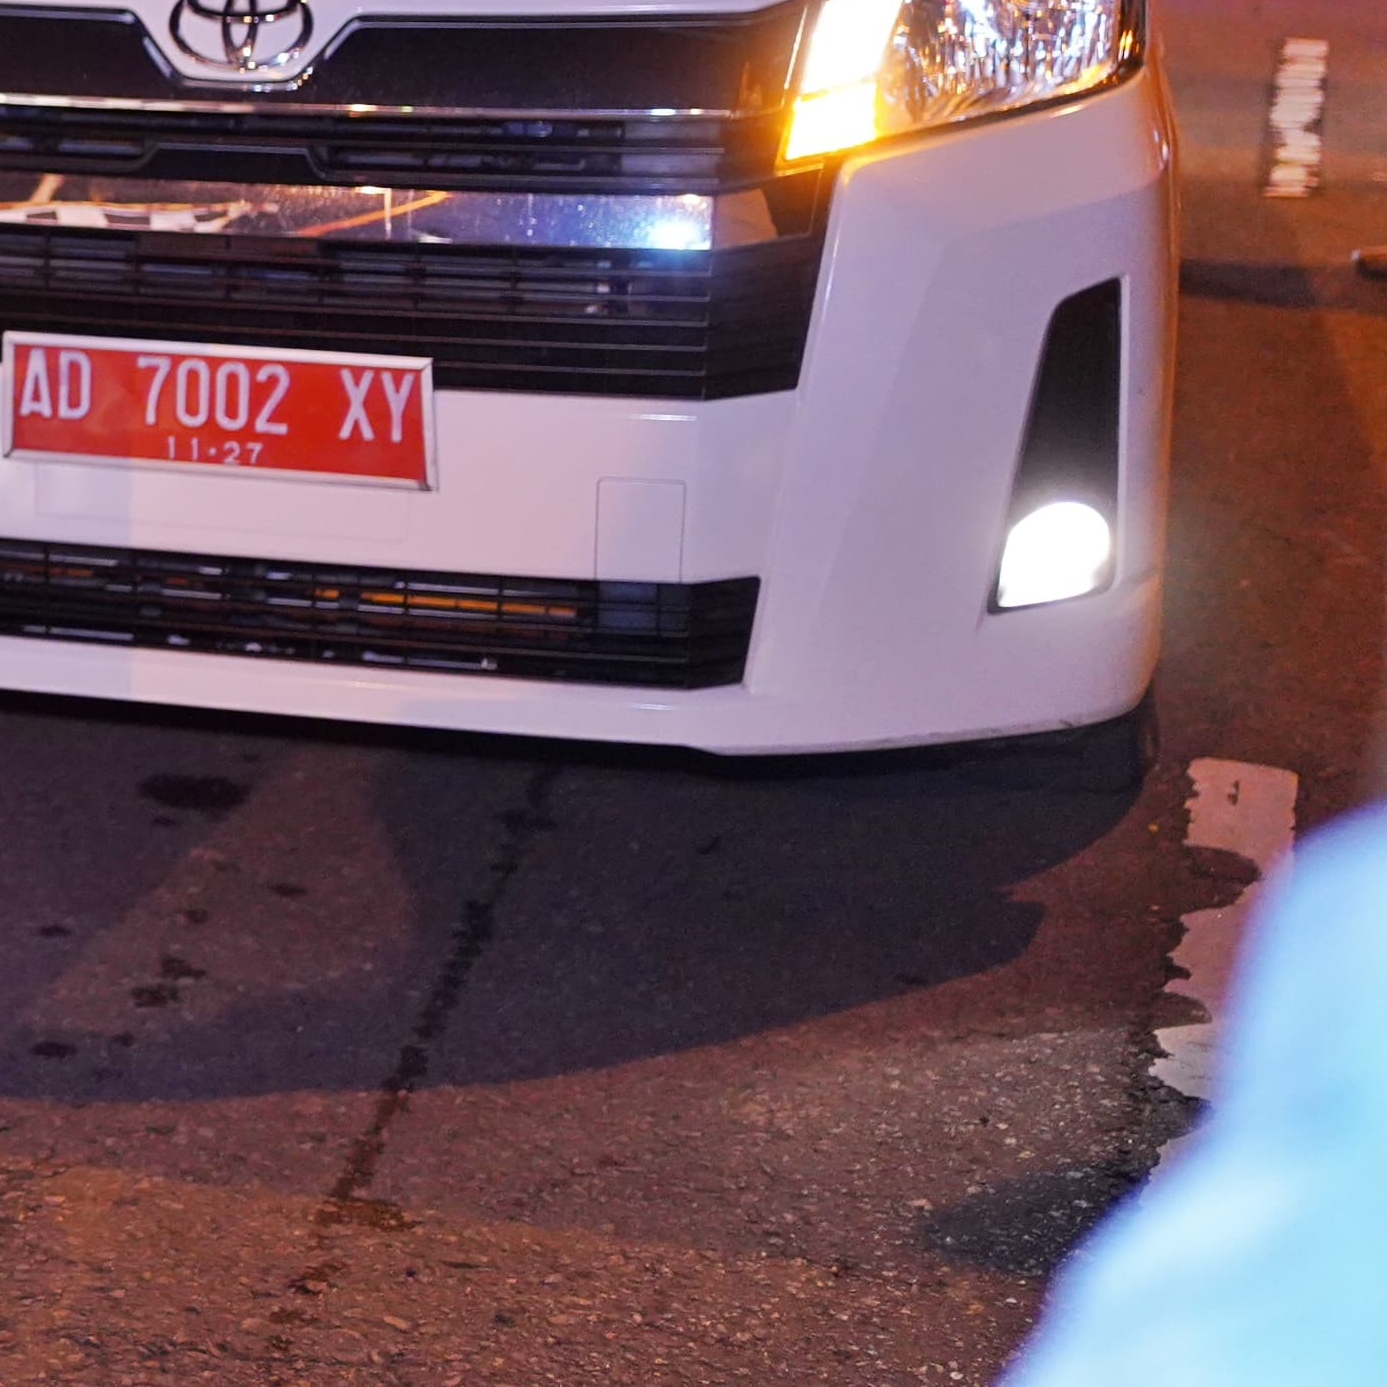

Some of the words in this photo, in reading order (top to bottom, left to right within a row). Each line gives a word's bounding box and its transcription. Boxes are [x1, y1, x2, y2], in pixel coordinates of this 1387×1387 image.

[19, 347, 92, 420] AD
[137, 356, 291, 436] 7002
[338, 368, 415, 444] XY
